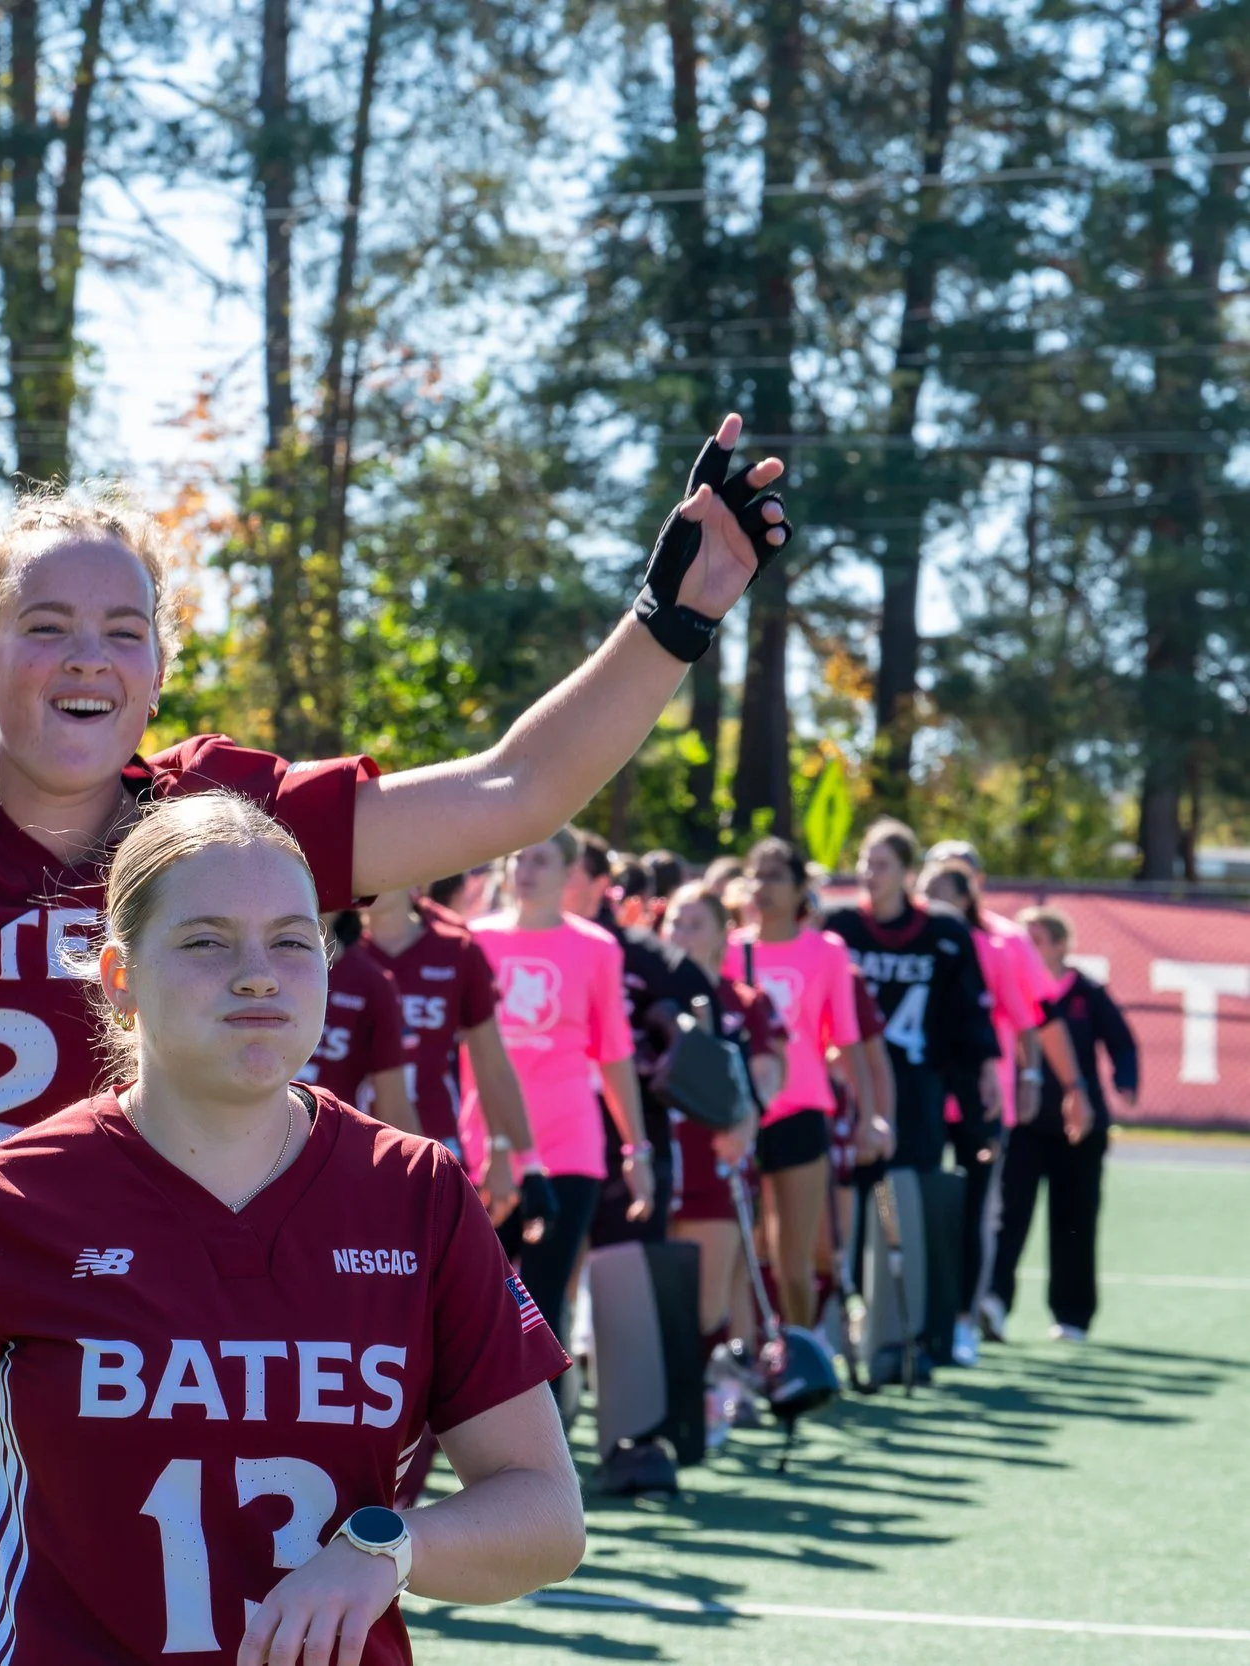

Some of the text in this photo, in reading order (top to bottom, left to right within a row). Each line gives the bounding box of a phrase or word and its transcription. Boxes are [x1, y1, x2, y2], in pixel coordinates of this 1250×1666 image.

[401, 994, 447, 1030] ES
[332, 1248, 418, 1276] NESCAC
[75, 1338, 407, 1429] BATES
[139, 1456, 338, 1654] 13
